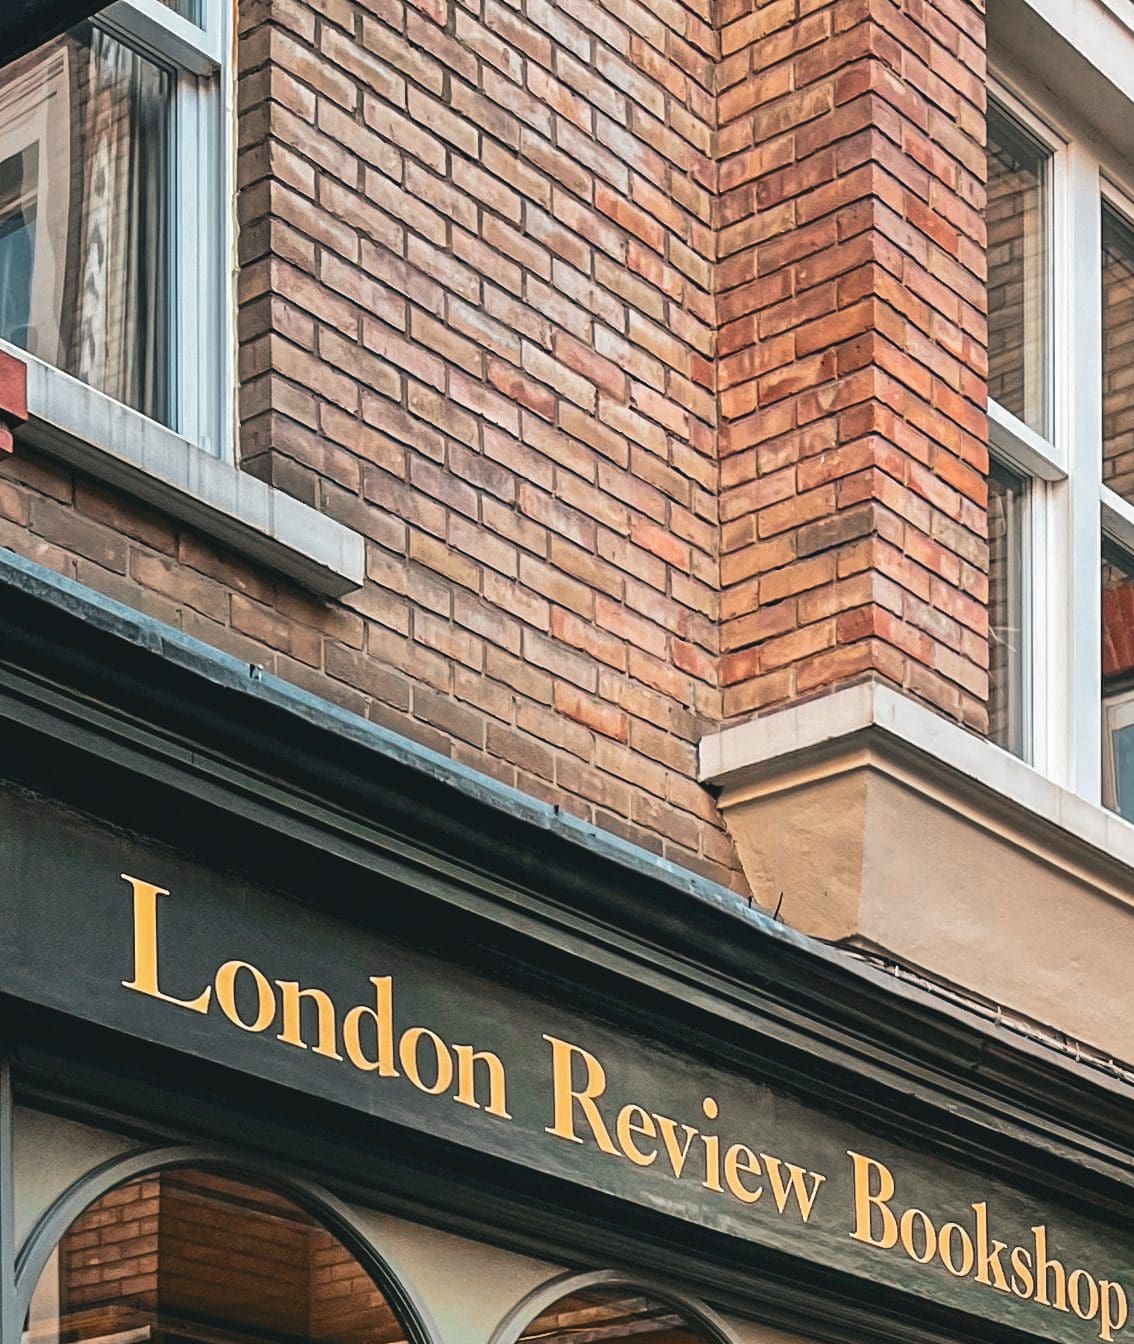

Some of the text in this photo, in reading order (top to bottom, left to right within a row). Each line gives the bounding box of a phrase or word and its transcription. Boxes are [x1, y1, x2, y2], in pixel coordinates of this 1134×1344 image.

[119, 873, 1130, 1344] London Review Bookshop
